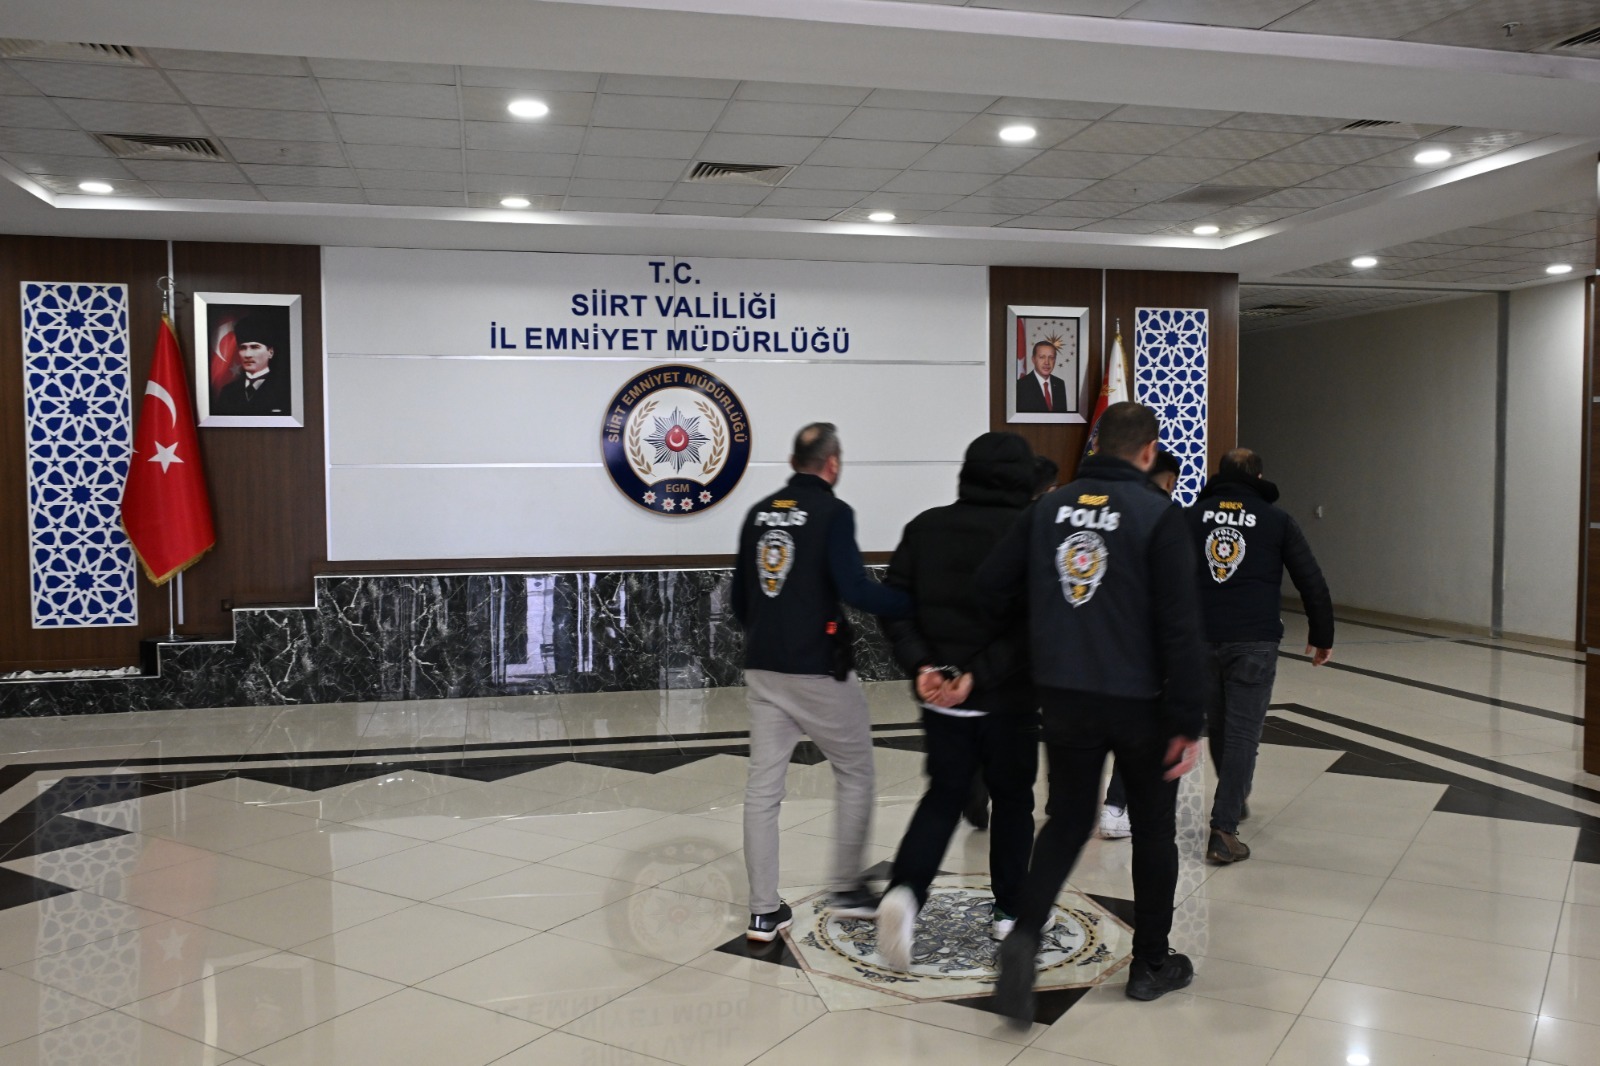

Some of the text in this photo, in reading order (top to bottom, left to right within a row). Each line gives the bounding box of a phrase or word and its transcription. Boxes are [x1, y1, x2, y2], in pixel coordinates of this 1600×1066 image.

[648, 261, 701, 285] T.C.
[571, 288, 777, 320] SİİRT VALİLİĞİ
[490, 321, 850, 354] İL EMNİYET MÜDÜRLÜĞÜ
[605, 371, 748, 443] SİİRT EMNİYET MÜDÜRLÜĞÜ
[665, 483, 690, 493] EGM
[1054, 505, 1122, 531] POLİS
[1202, 509, 1257, 527] POLİS
